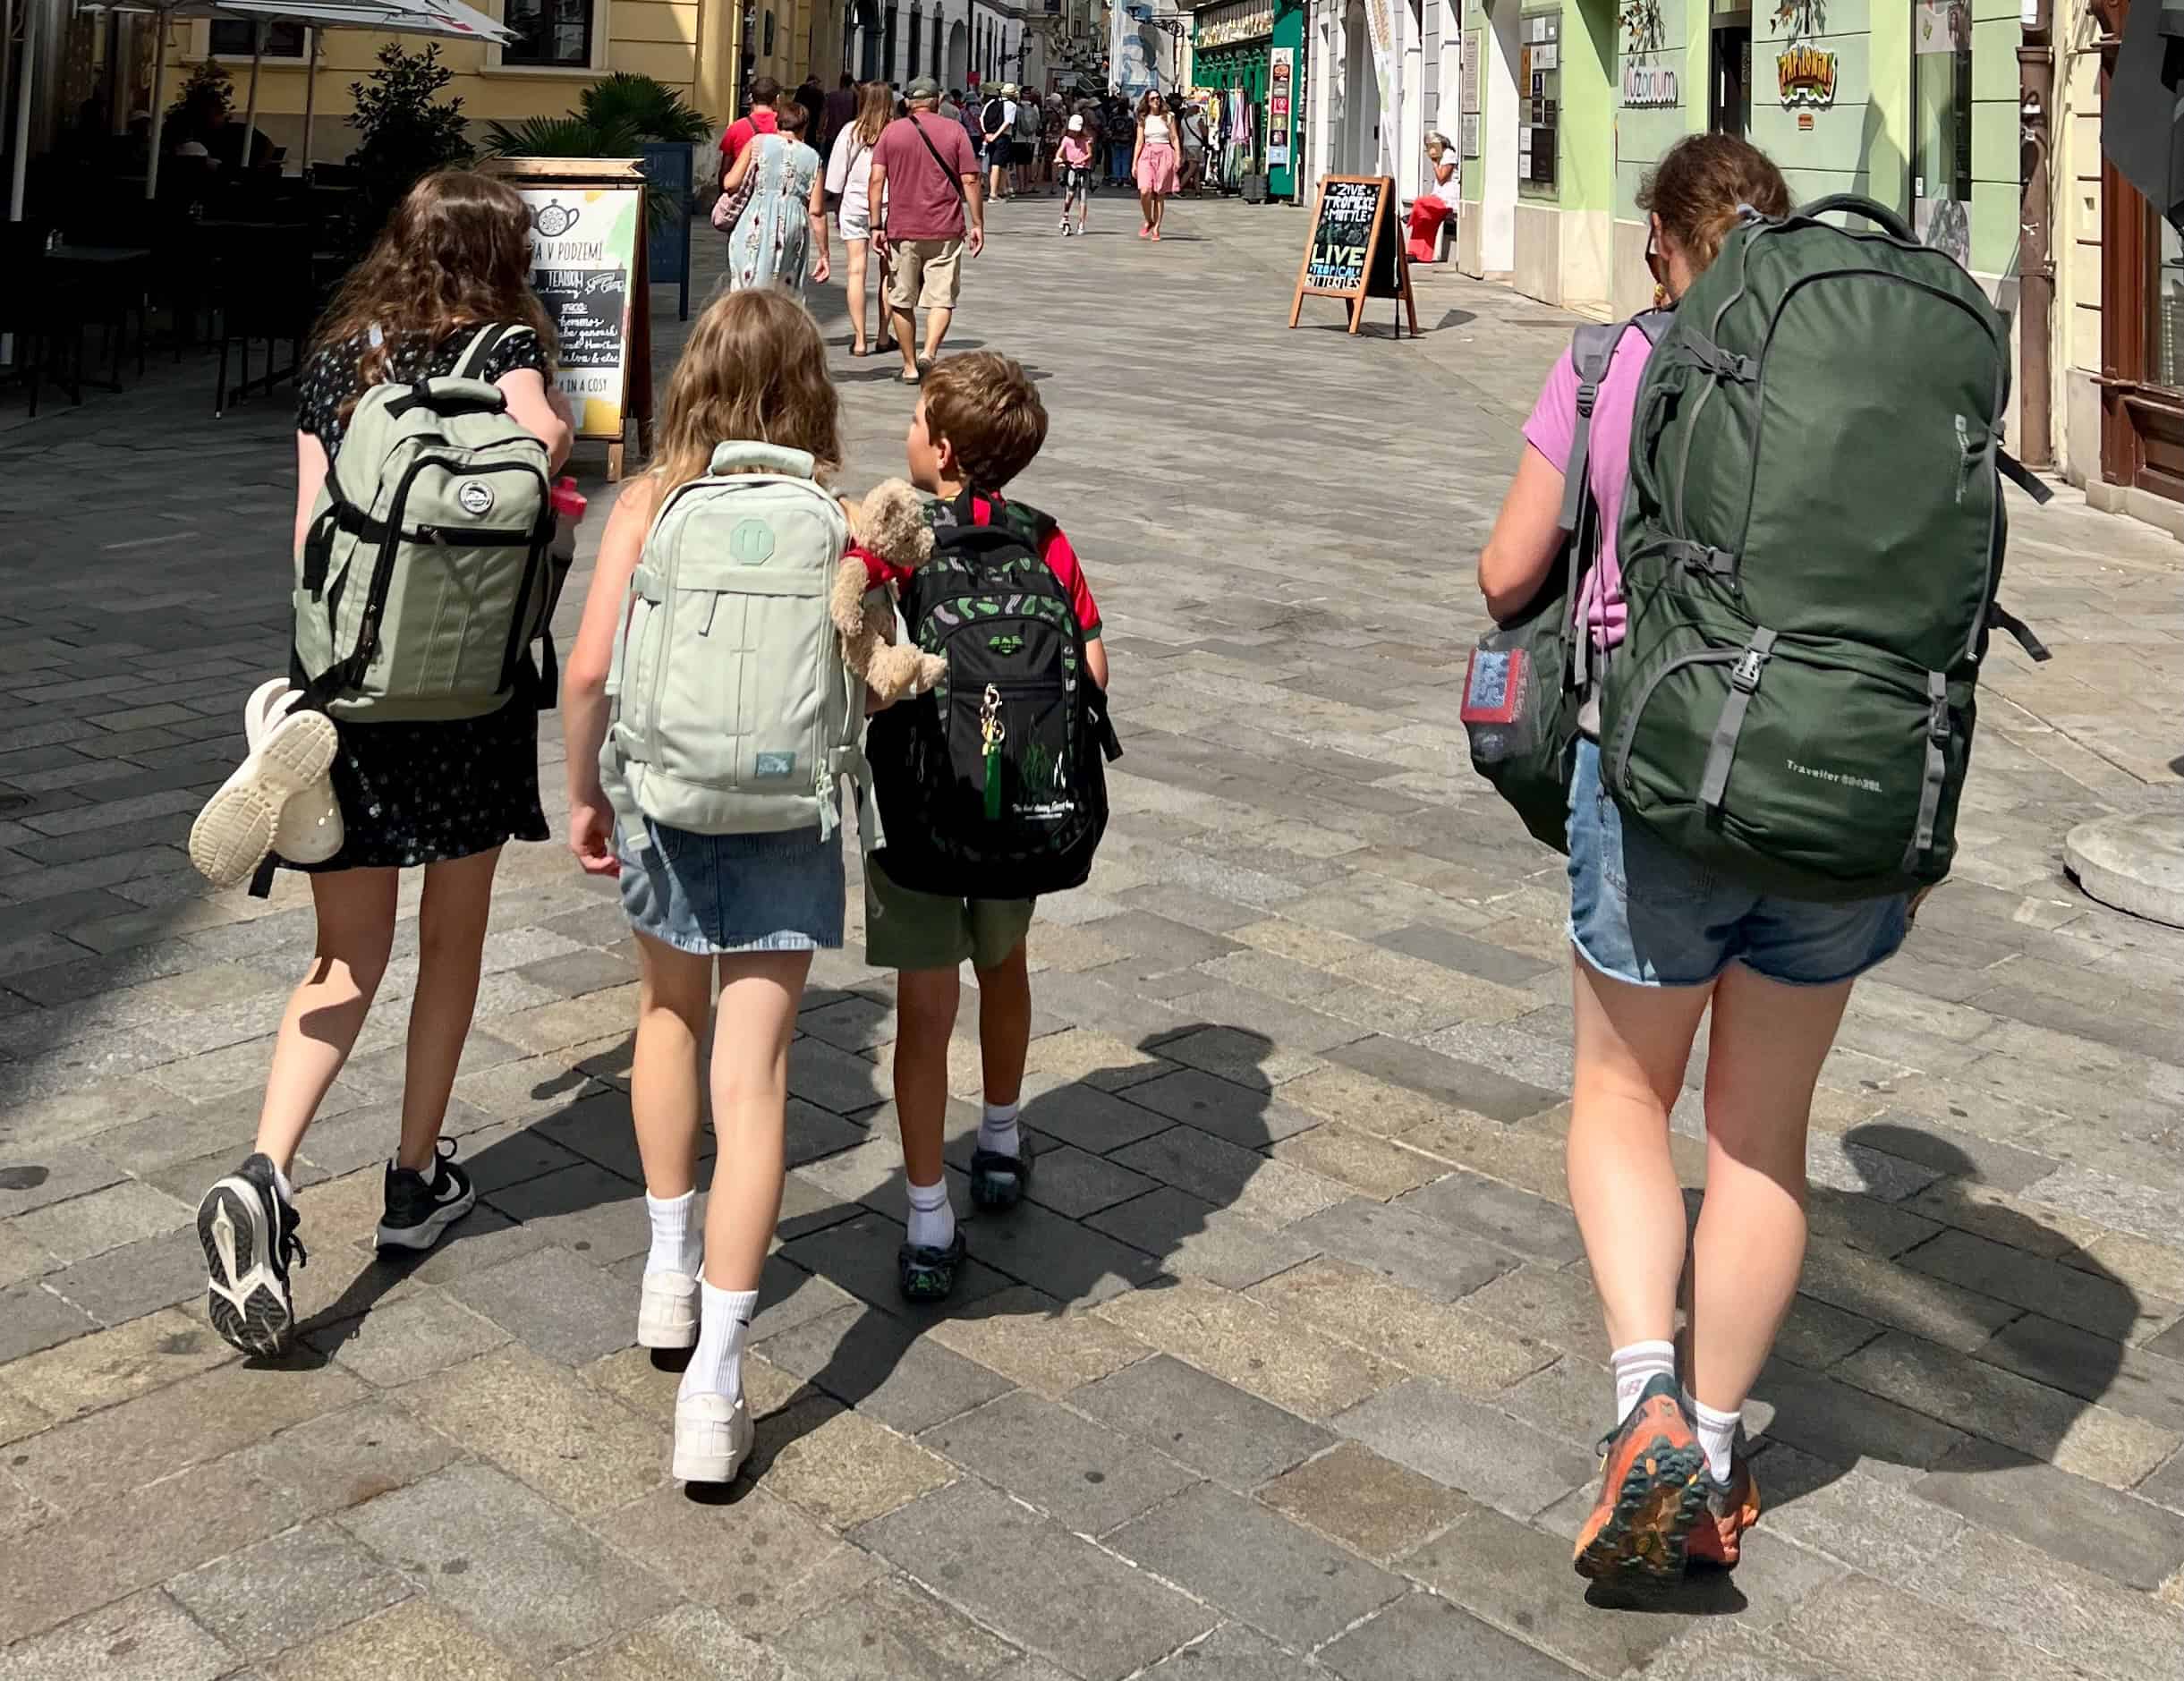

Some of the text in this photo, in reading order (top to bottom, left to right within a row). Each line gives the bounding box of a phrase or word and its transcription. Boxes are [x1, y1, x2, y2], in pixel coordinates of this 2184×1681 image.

[548, 242, 555, 259] V
[1311, 243, 1366, 267] LIVE
[567, 379, 577, 392] IN
